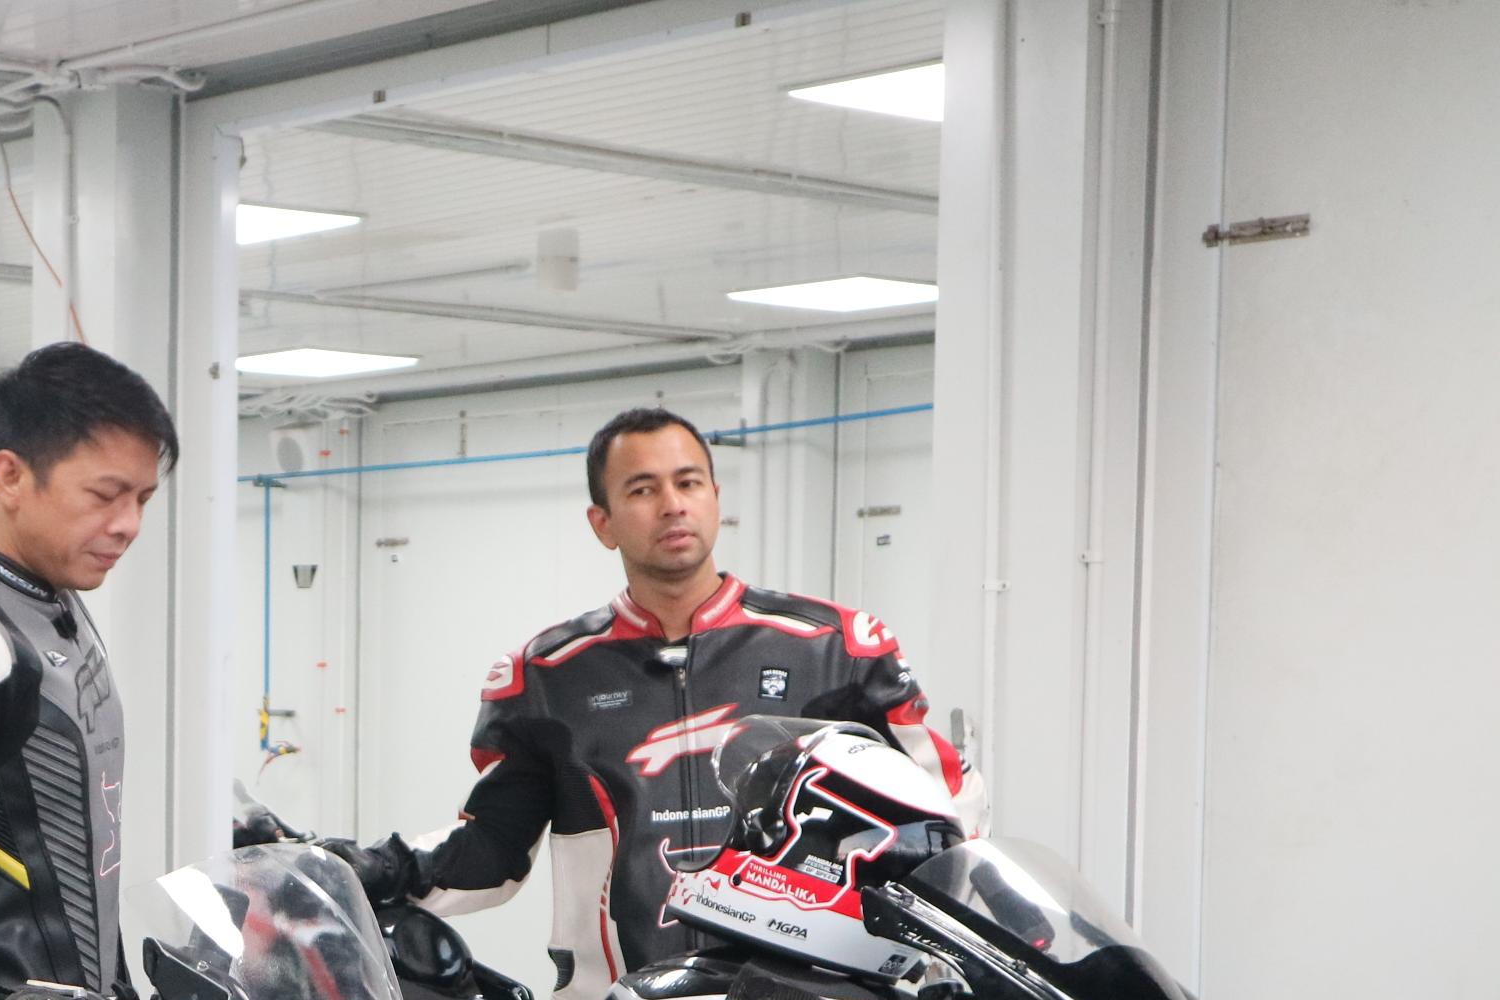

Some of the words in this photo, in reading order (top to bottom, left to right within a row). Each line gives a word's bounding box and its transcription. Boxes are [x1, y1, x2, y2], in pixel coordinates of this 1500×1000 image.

[749, 862, 787, 882] THRILLING
[745, 871, 817, 904] MANDALIKA
[695, 891, 756, 923] IndonesianGP
[767, 918, 809, 939] MGPA
